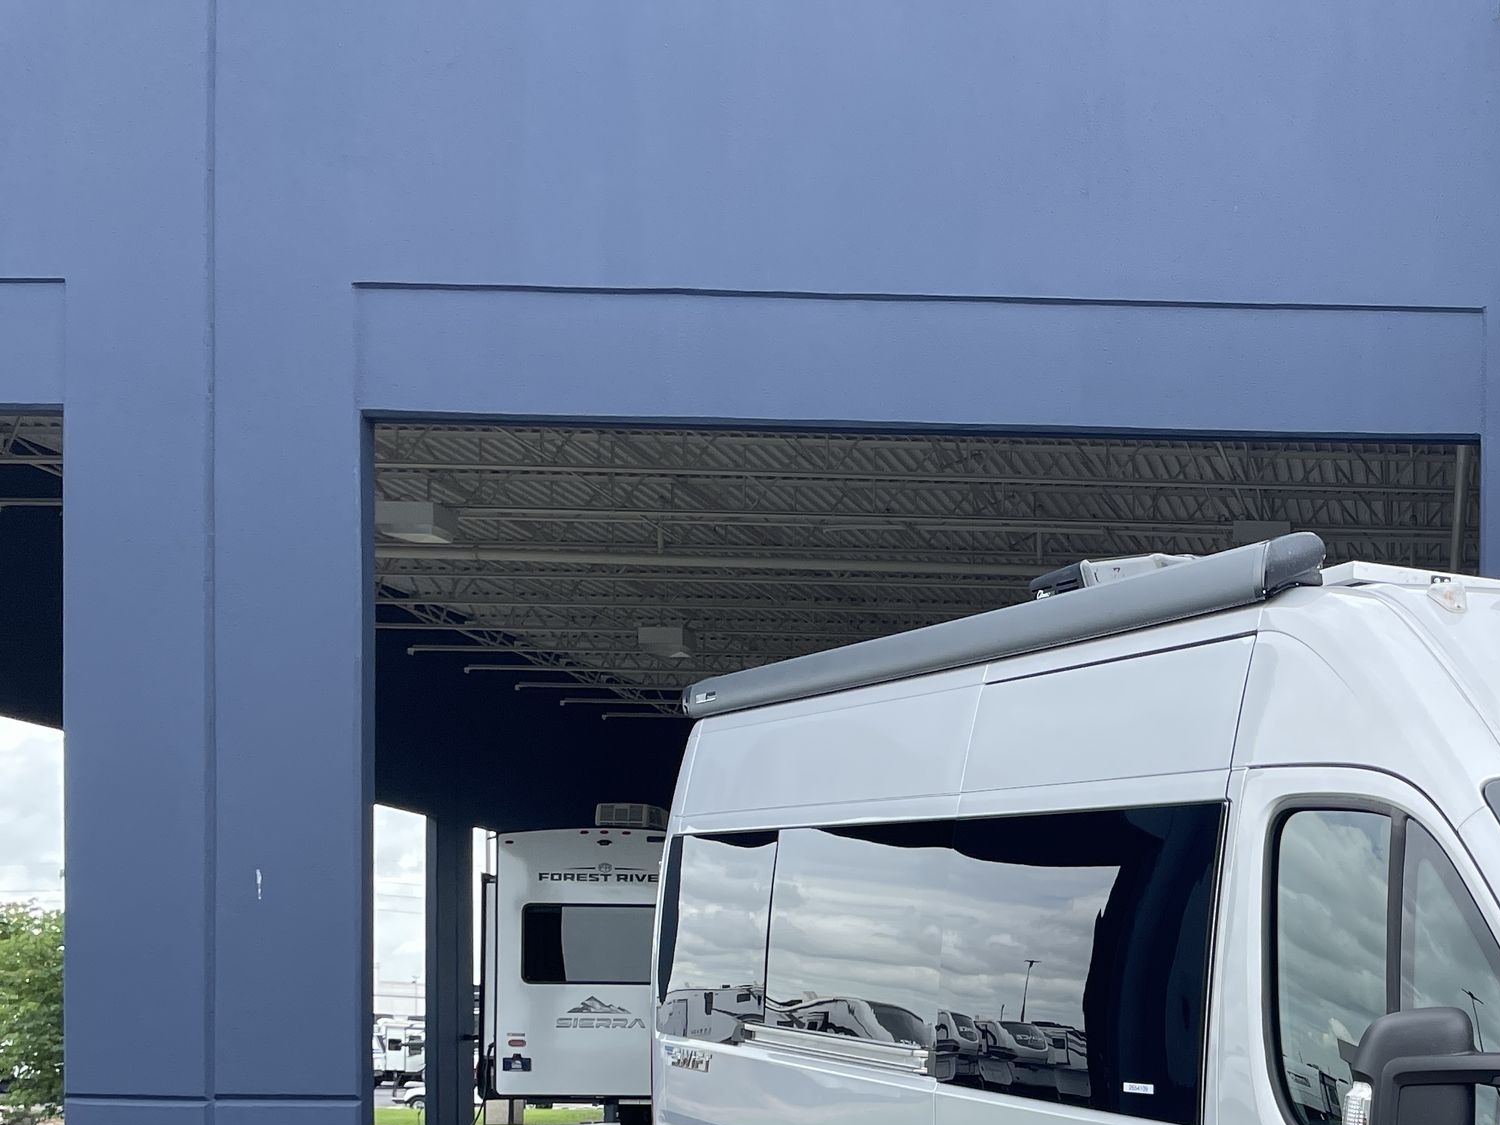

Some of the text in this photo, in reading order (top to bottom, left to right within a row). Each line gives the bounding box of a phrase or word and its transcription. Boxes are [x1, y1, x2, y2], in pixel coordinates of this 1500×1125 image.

[538, 872, 659, 883] FOREST RIVE
[555, 1017, 646, 1029] SIERRA
